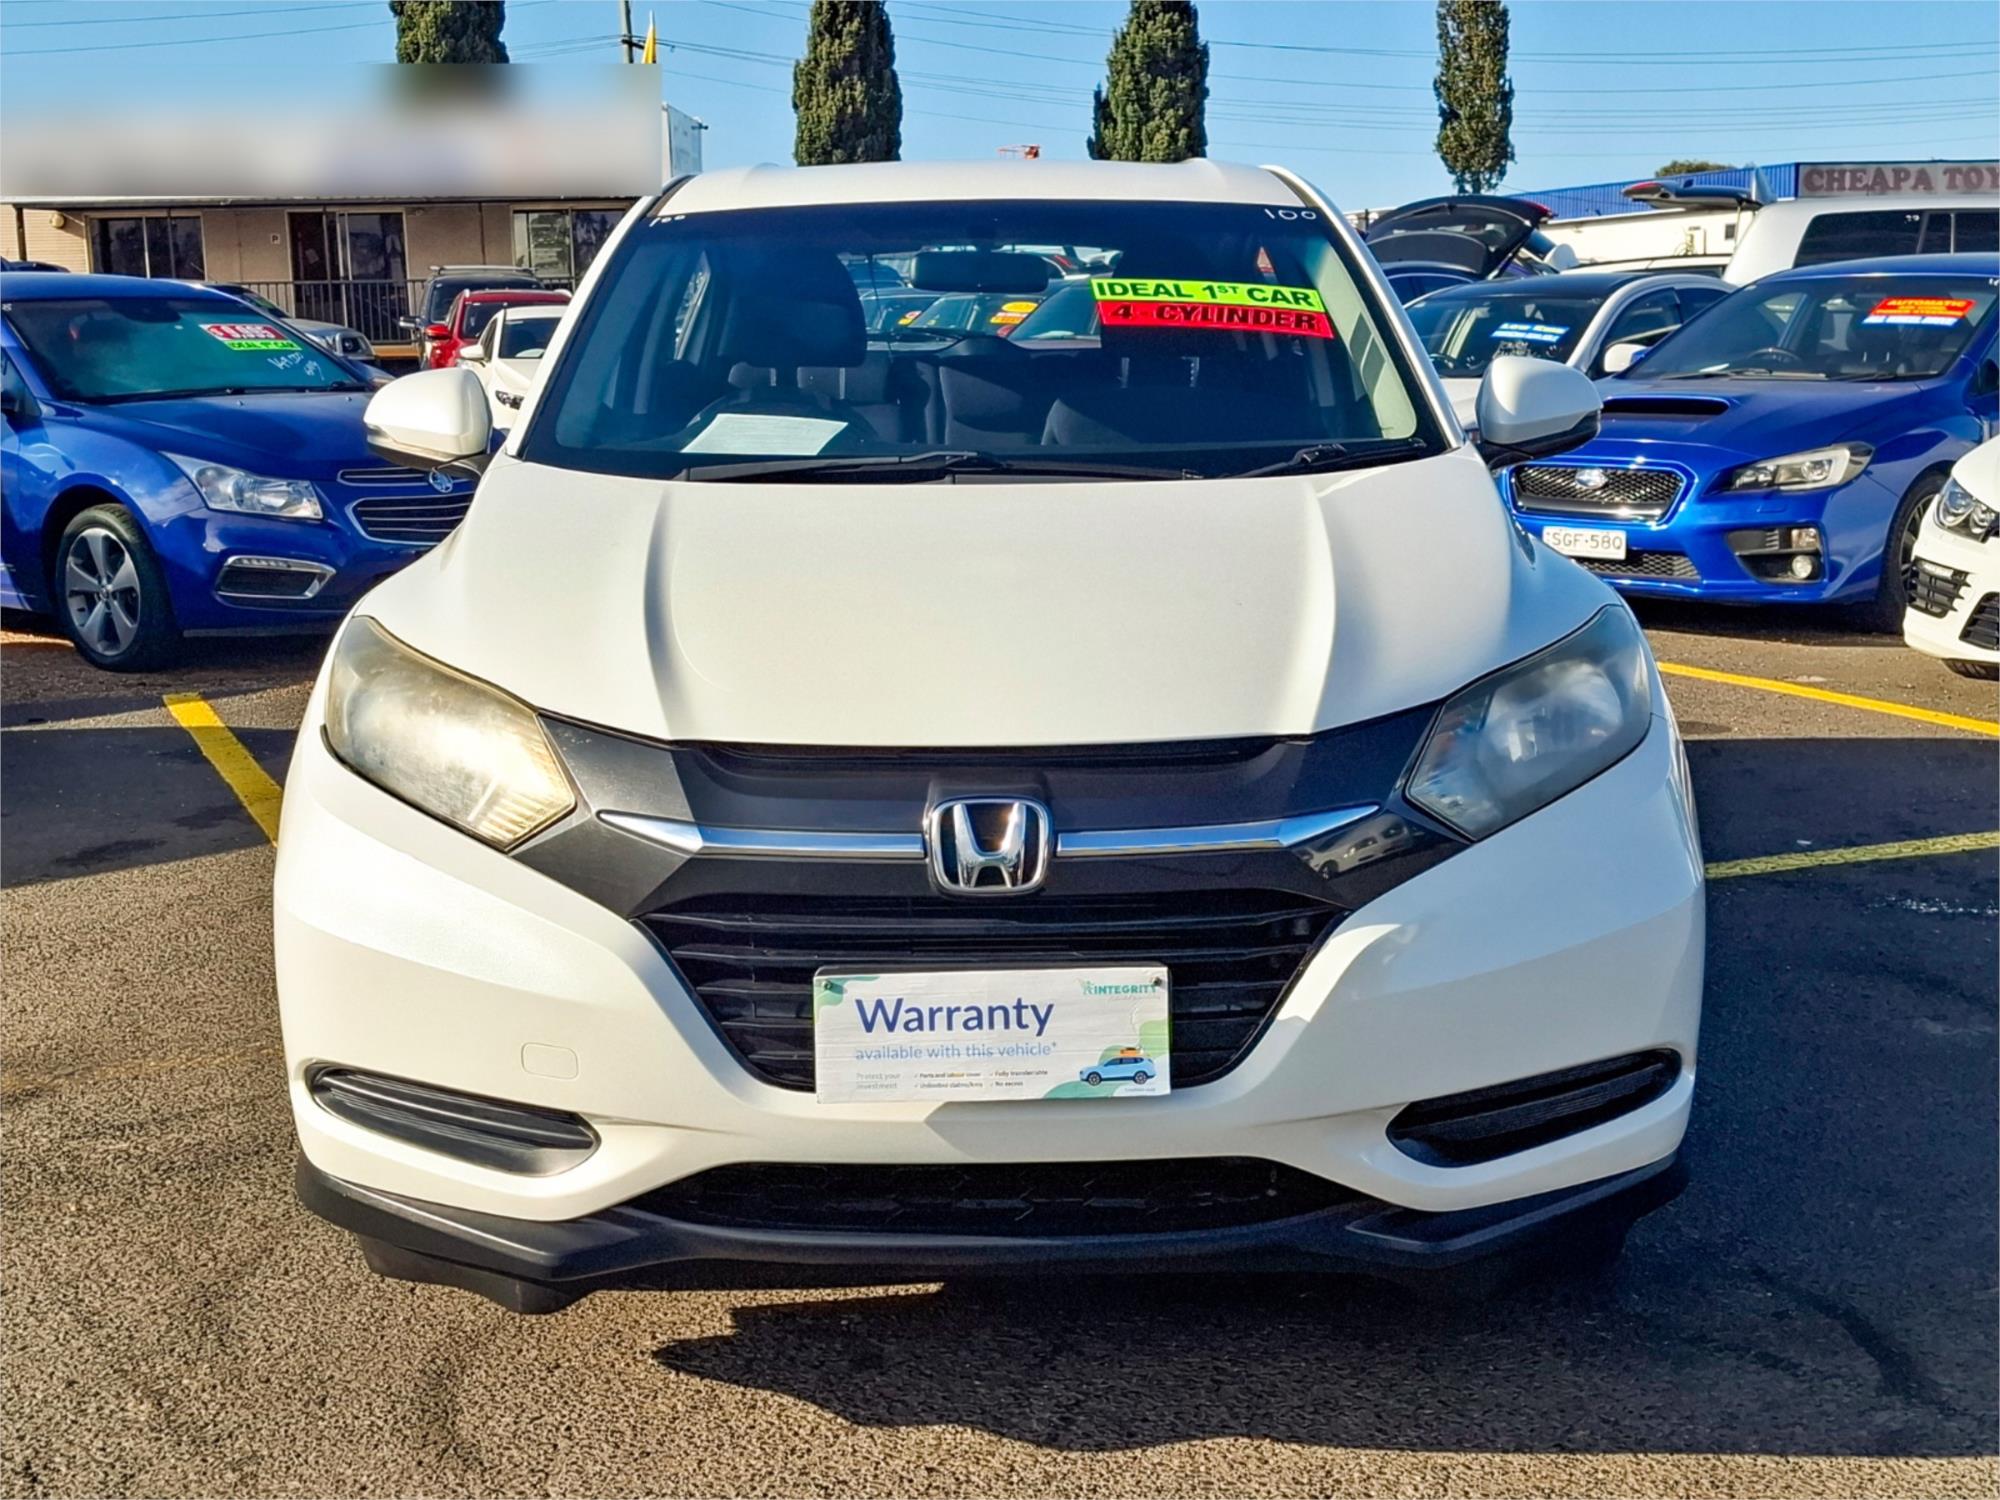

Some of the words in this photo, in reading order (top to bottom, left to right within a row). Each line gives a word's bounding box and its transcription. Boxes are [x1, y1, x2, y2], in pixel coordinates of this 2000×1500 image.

[1803, 166, 1934, 192] CHEAPA
[1264, 208, 1317, 220] 100
[1099, 281, 1195, 299] IDEAL
[1202, 283, 1240, 300] 1ST
[1246, 287, 1316, 307] CAR
[1110, 304, 1134, 320] 4
[1155, 304, 1317, 331] CYLINDER
[855, 997, 1055, 1037] Warranty
[856, 1045, 923, 1060] available
[927, 1044, 961, 1059] with
[966, 1043, 994, 1058] this
